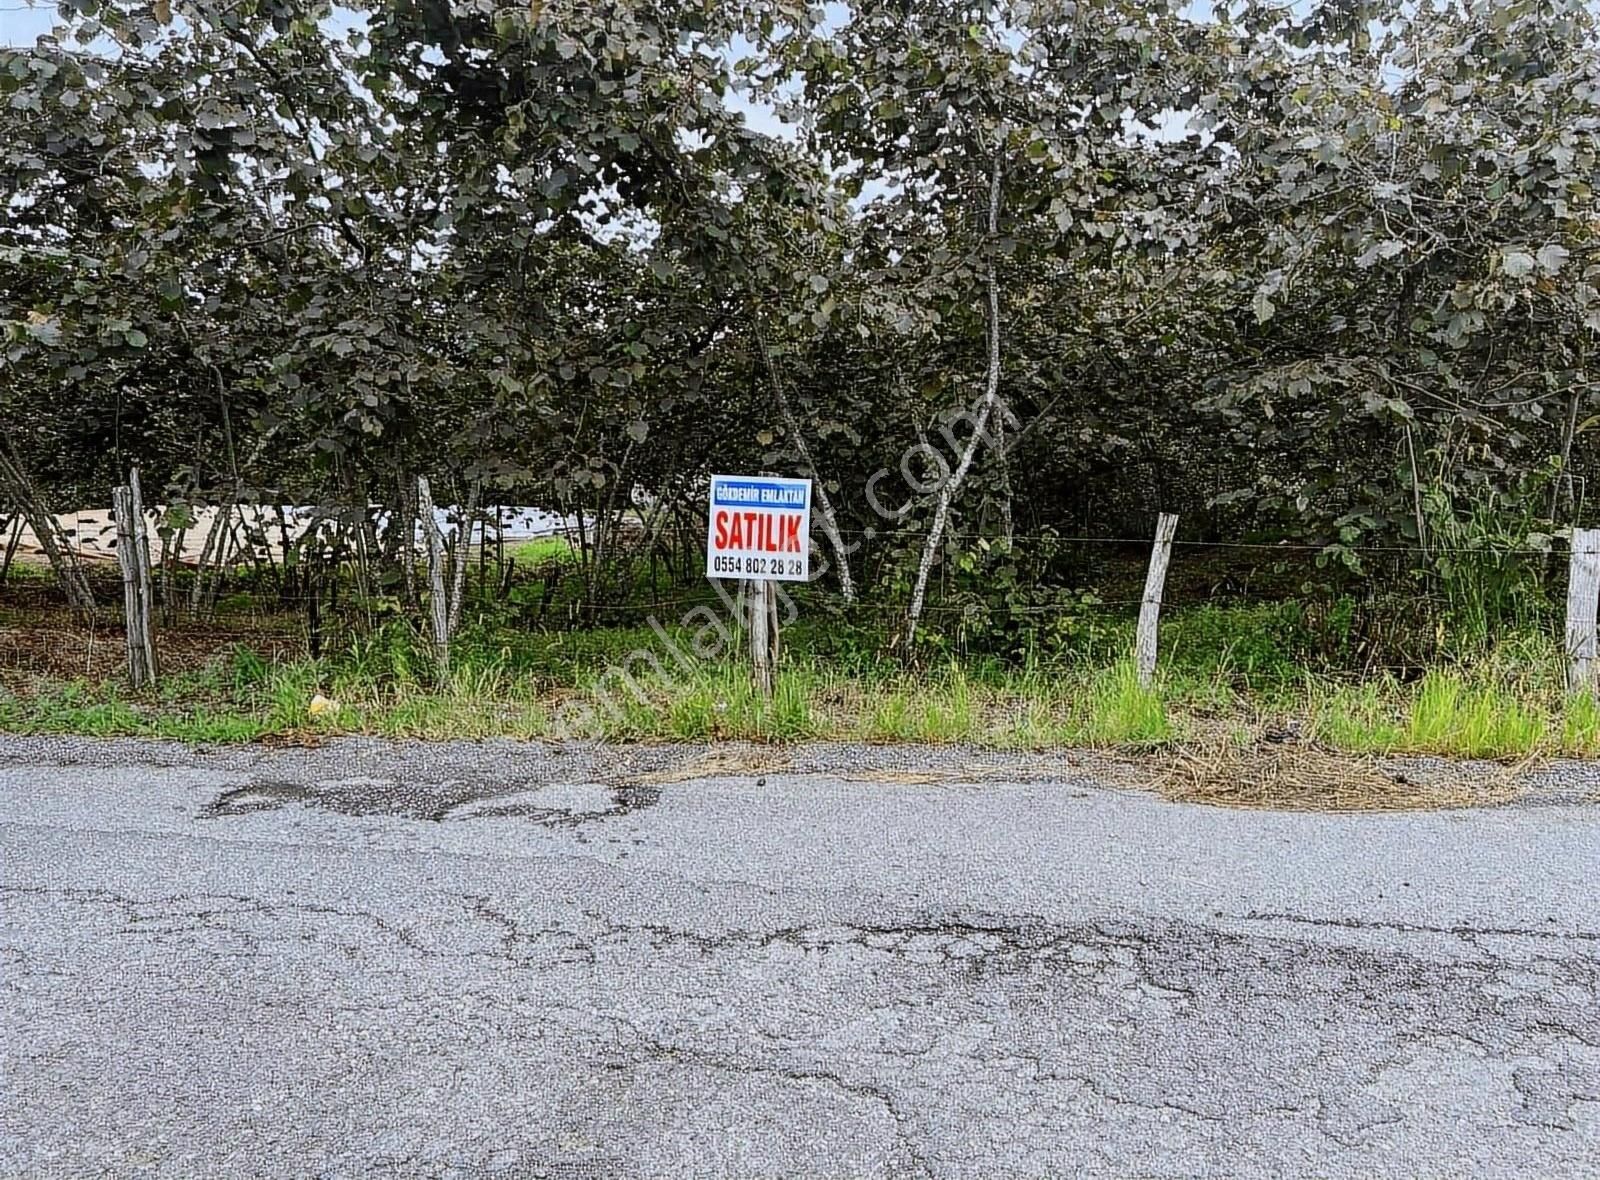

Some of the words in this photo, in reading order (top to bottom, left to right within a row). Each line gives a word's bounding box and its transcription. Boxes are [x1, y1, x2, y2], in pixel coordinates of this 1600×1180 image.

[716, 484, 759, 502] GÖKDEMİR
[761, 488, 805, 505] EMLAKTAN
[715, 510, 802, 553] SATILIK
[714, 556, 741, 572] 0554
[746, 558, 766, 574] 802
[770, 558, 784, 575] 28
[788, 560, 802, 575] 28
